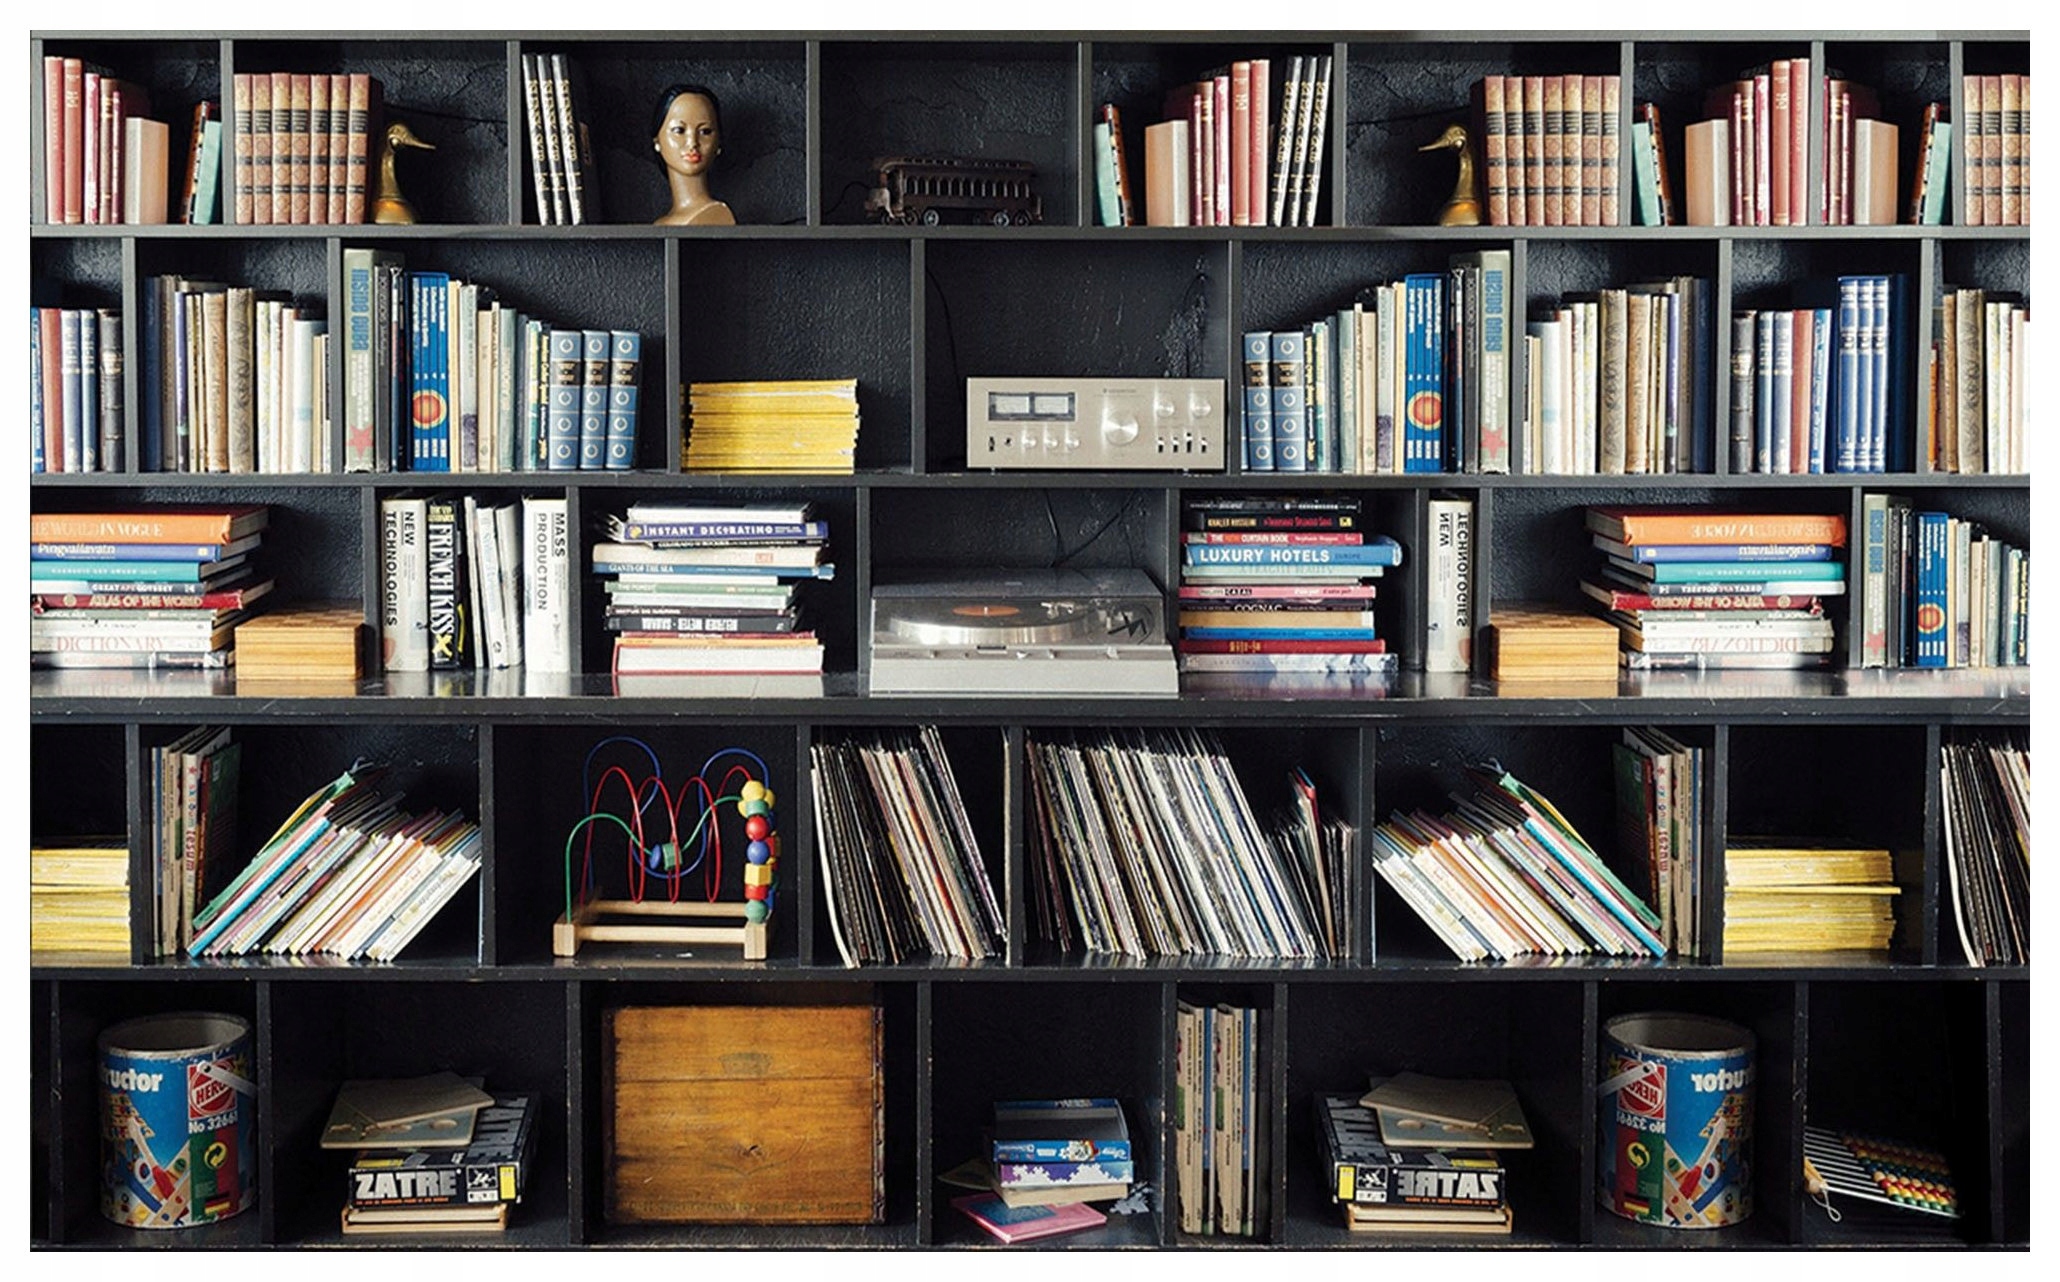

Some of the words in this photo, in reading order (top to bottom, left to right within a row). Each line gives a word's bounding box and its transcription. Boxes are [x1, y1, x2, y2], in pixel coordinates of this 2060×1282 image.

[100, 522, 117, 536] IN
[117, 522, 164, 536] VOGUE
[404, 511, 416, 546] NEW
[554, 512, 566, 558] MASS
[643, 524, 695, 536] INSTANT
[1210, 534, 1224, 543] THE
[1270, 534, 1289, 543] BOOK
[428, 523, 455, 591] FRENCH
[536, 512, 548, 611] PRODUCTION
[1200, 549, 1264, 563] LUXURY
[1270, 549, 1330, 563] HOTELS
[386, 511, 398, 627] TECHNOLOGIES
[89, 595, 124, 608] ATLAS
[125, 595, 140, 608] OF
[141, 595, 164, 608] THE
[164, 595, 203, 608] WORLD
[1234, 604, 1283, 613] COGNAC
[429, 594, 454, 634] KISS
[56, 636, 165, 651] DICTIONARY
[188, 1119, 205, 1135] No
[355, 1170, 457, 1200] ZATRE
